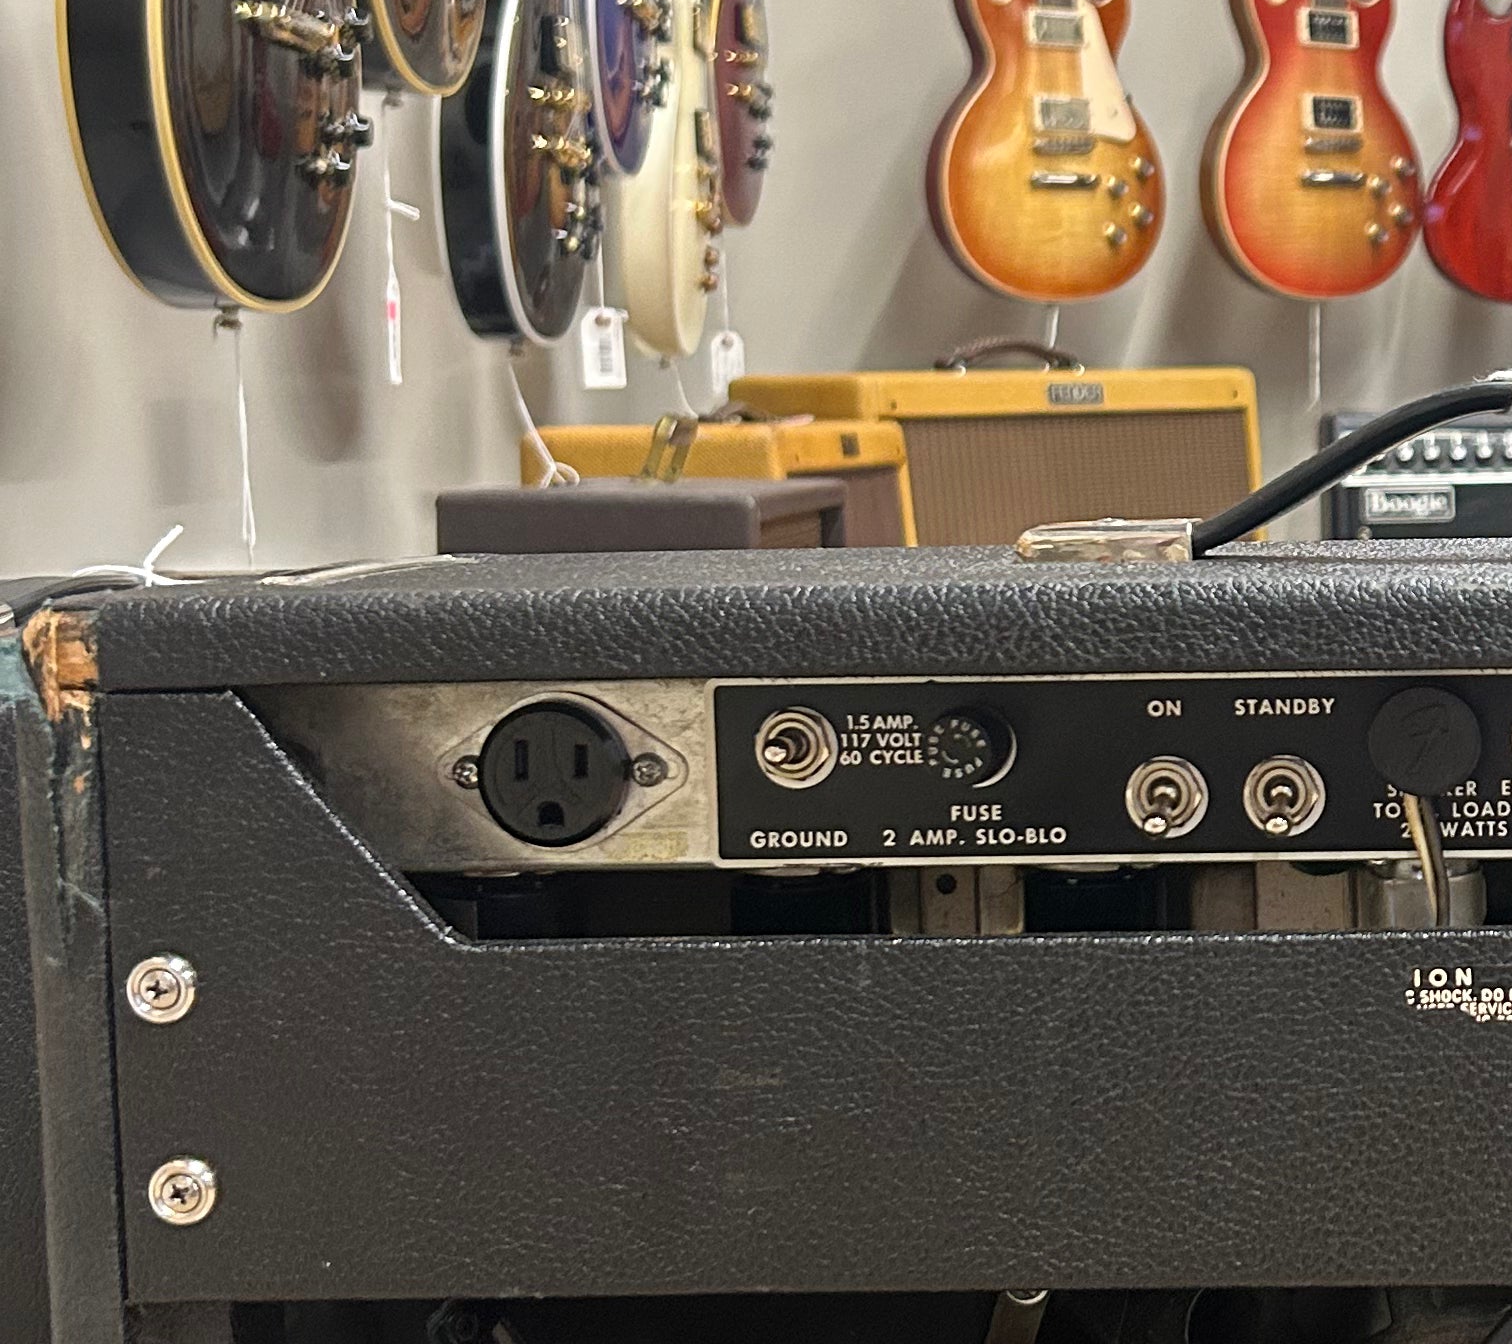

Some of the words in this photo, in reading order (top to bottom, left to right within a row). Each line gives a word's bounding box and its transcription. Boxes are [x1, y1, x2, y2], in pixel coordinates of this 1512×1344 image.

[1147, 700, 1182, 717] ON
[1234, 698, 1335, 716] STANDBY
[847, 714, 870, 730] 1.5
[873, 714, 919, 730] AMP.
[841, 733, 872, 748] 117
[876, 733, 922, 748] VOLT
[840, 750, 863, 766] 60
[869, 749, 924, 766] CYCLE
[950, 804, 1003, 822] FUSE
[1452, 801, 1512, 819] LOAD
[883, 829, 897, 847] 2
[909, 829, 966, 846] AMP.
[976, 827, 1067, 845] SLO-BLO
[1439, 820, 1508, 838] WATTS
[750, 830, 849, 849] GROUND
[1481, 988, 1504, 1002] DO
